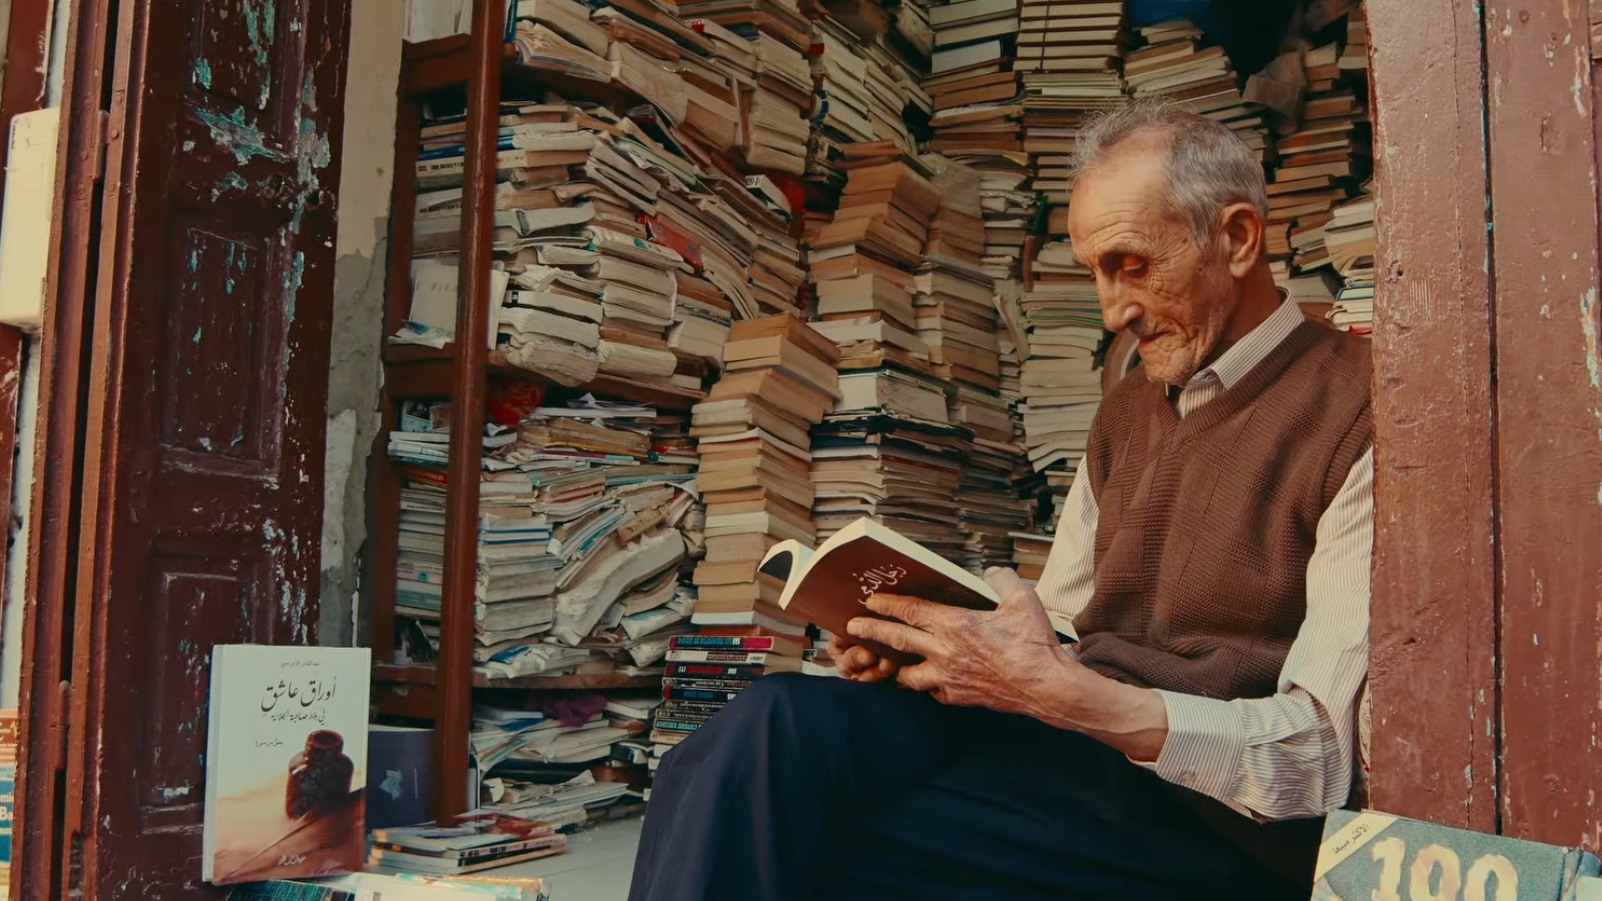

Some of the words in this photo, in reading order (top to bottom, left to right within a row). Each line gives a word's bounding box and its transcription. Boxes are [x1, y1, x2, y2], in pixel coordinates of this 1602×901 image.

[261, 680, 298, 712] عاشق
[300, 675, 337, 708] أوراق
[1371, 836, 1519, 901] 100
